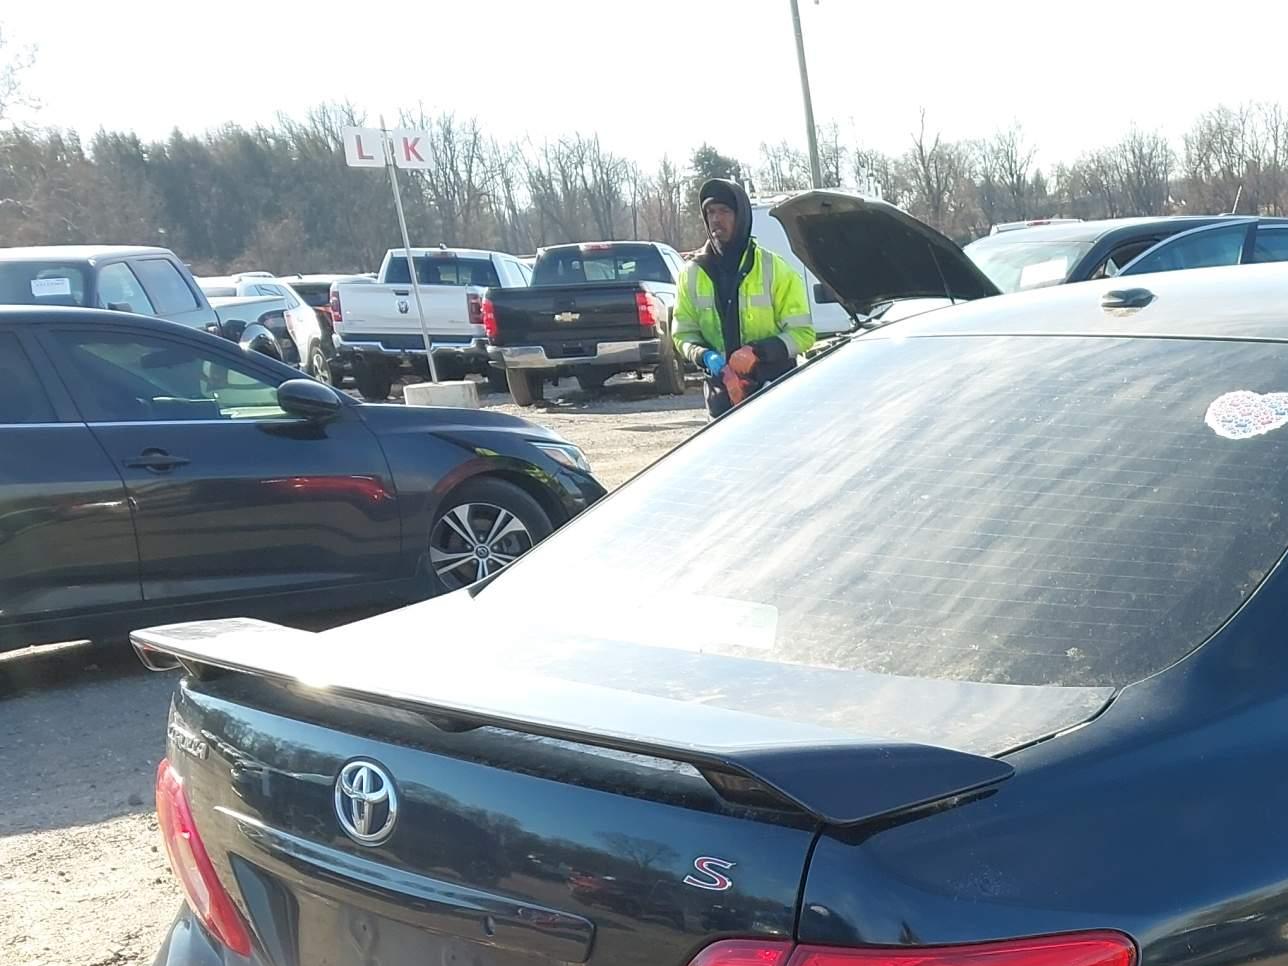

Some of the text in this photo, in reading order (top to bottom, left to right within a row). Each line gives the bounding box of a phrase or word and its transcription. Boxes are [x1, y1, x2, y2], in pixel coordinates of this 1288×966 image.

[355, 134, 375, 160] L
[402, 136, 425, 162] K
[683, 856, 737, 891] S
